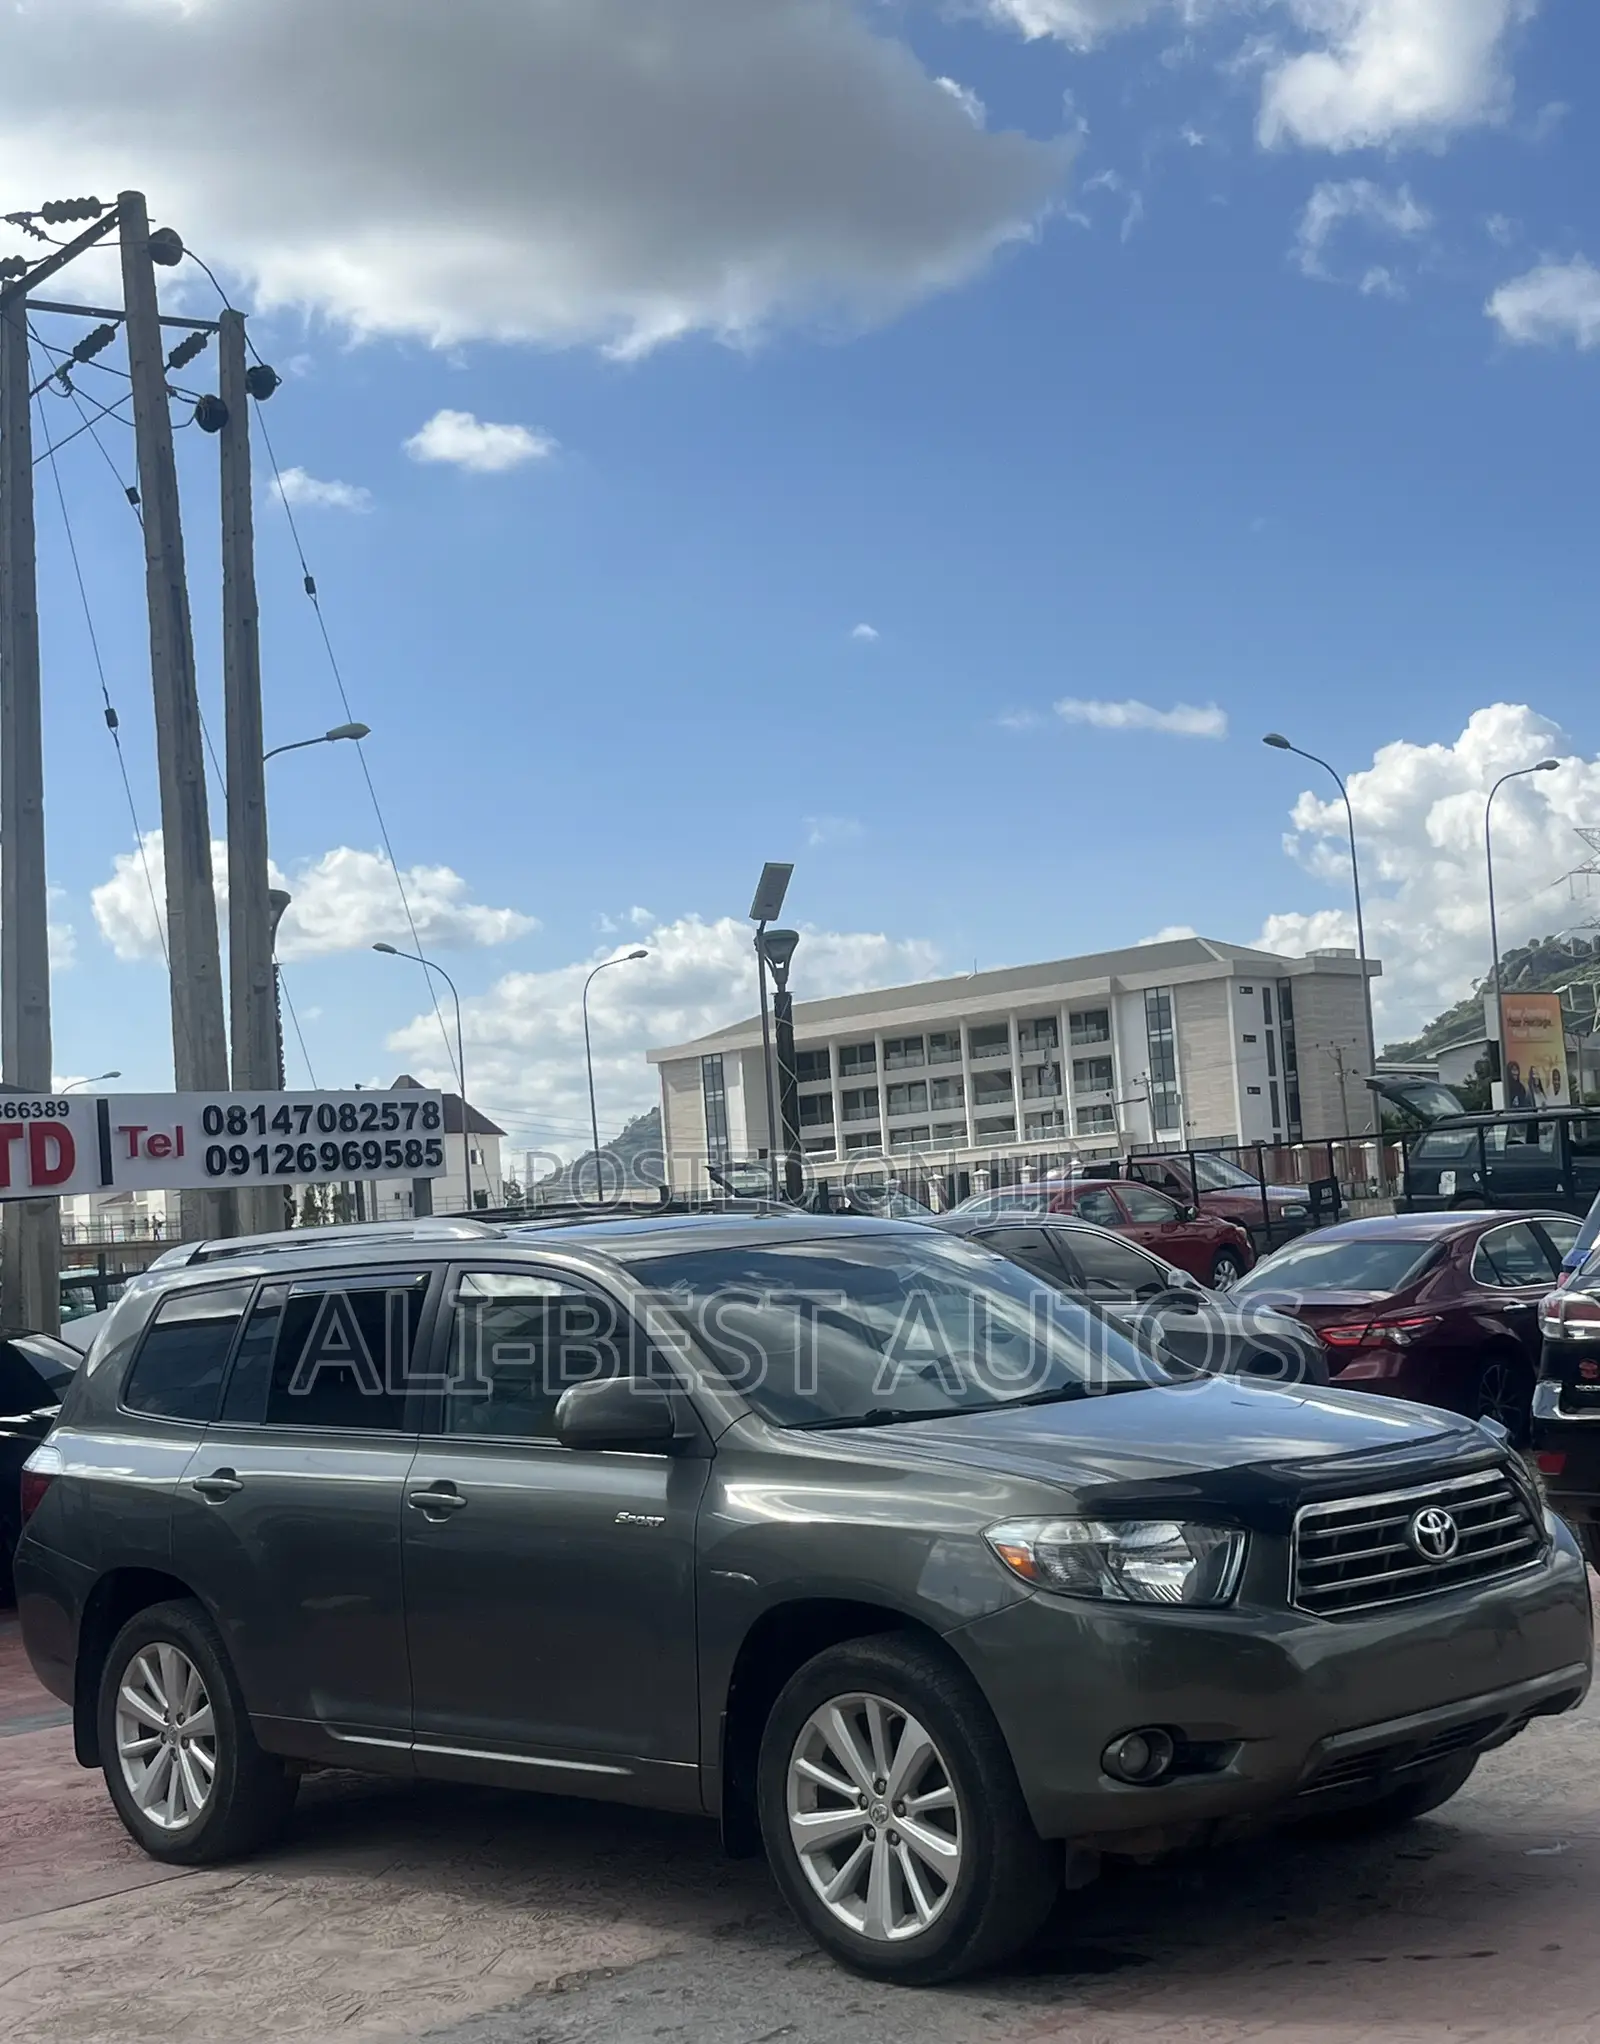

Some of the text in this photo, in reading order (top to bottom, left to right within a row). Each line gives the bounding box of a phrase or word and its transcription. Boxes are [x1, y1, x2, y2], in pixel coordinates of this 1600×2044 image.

[0, 1101, 70, 1119] 66389
[202, 1101, 441, 1136] 08147082578
[118, 1125, 184, 1159] Tel
[205, 1138, 443, 1176] 09126969585
